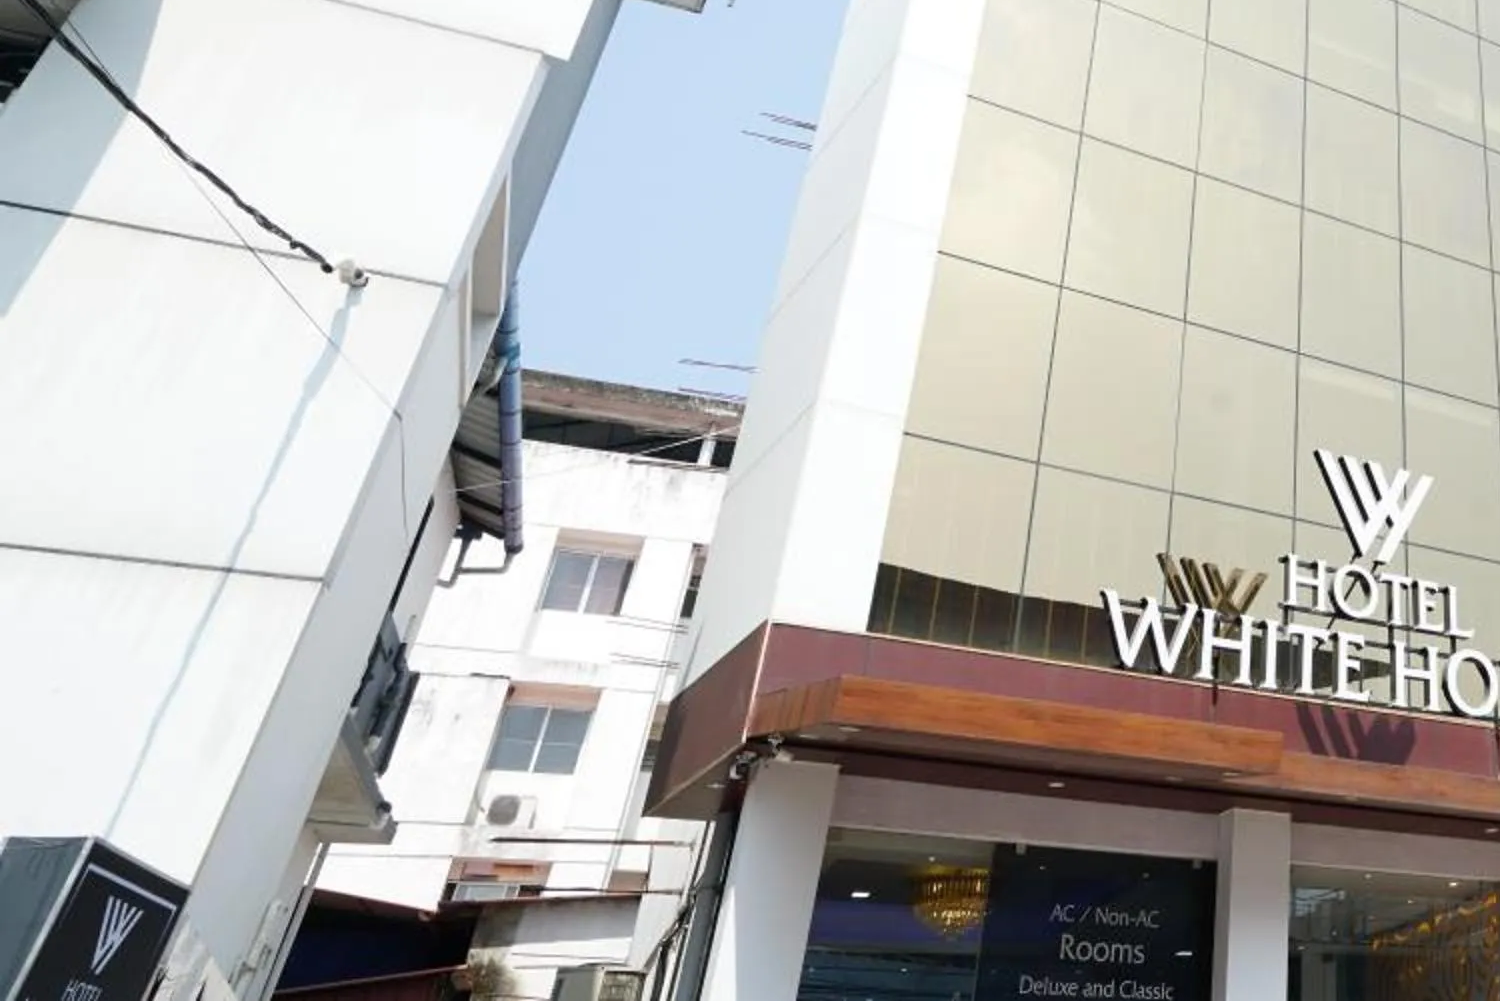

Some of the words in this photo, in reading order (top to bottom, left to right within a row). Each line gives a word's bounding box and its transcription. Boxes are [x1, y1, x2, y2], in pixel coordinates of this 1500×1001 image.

[1280, 553, 1475, 640] HOTEL
[1101, 587, 1373, 702] WHITE
[1050, 903, 1075, 923] AC
[1095, 906, 1161, 929] Non-AC
[1059, 933, 1146, 965] Rooms
[1019, 974, 1079, 997] Deluxe
[1083, 978, 1115, 999] and
[1119, 980, 1175, 1001] Classic
